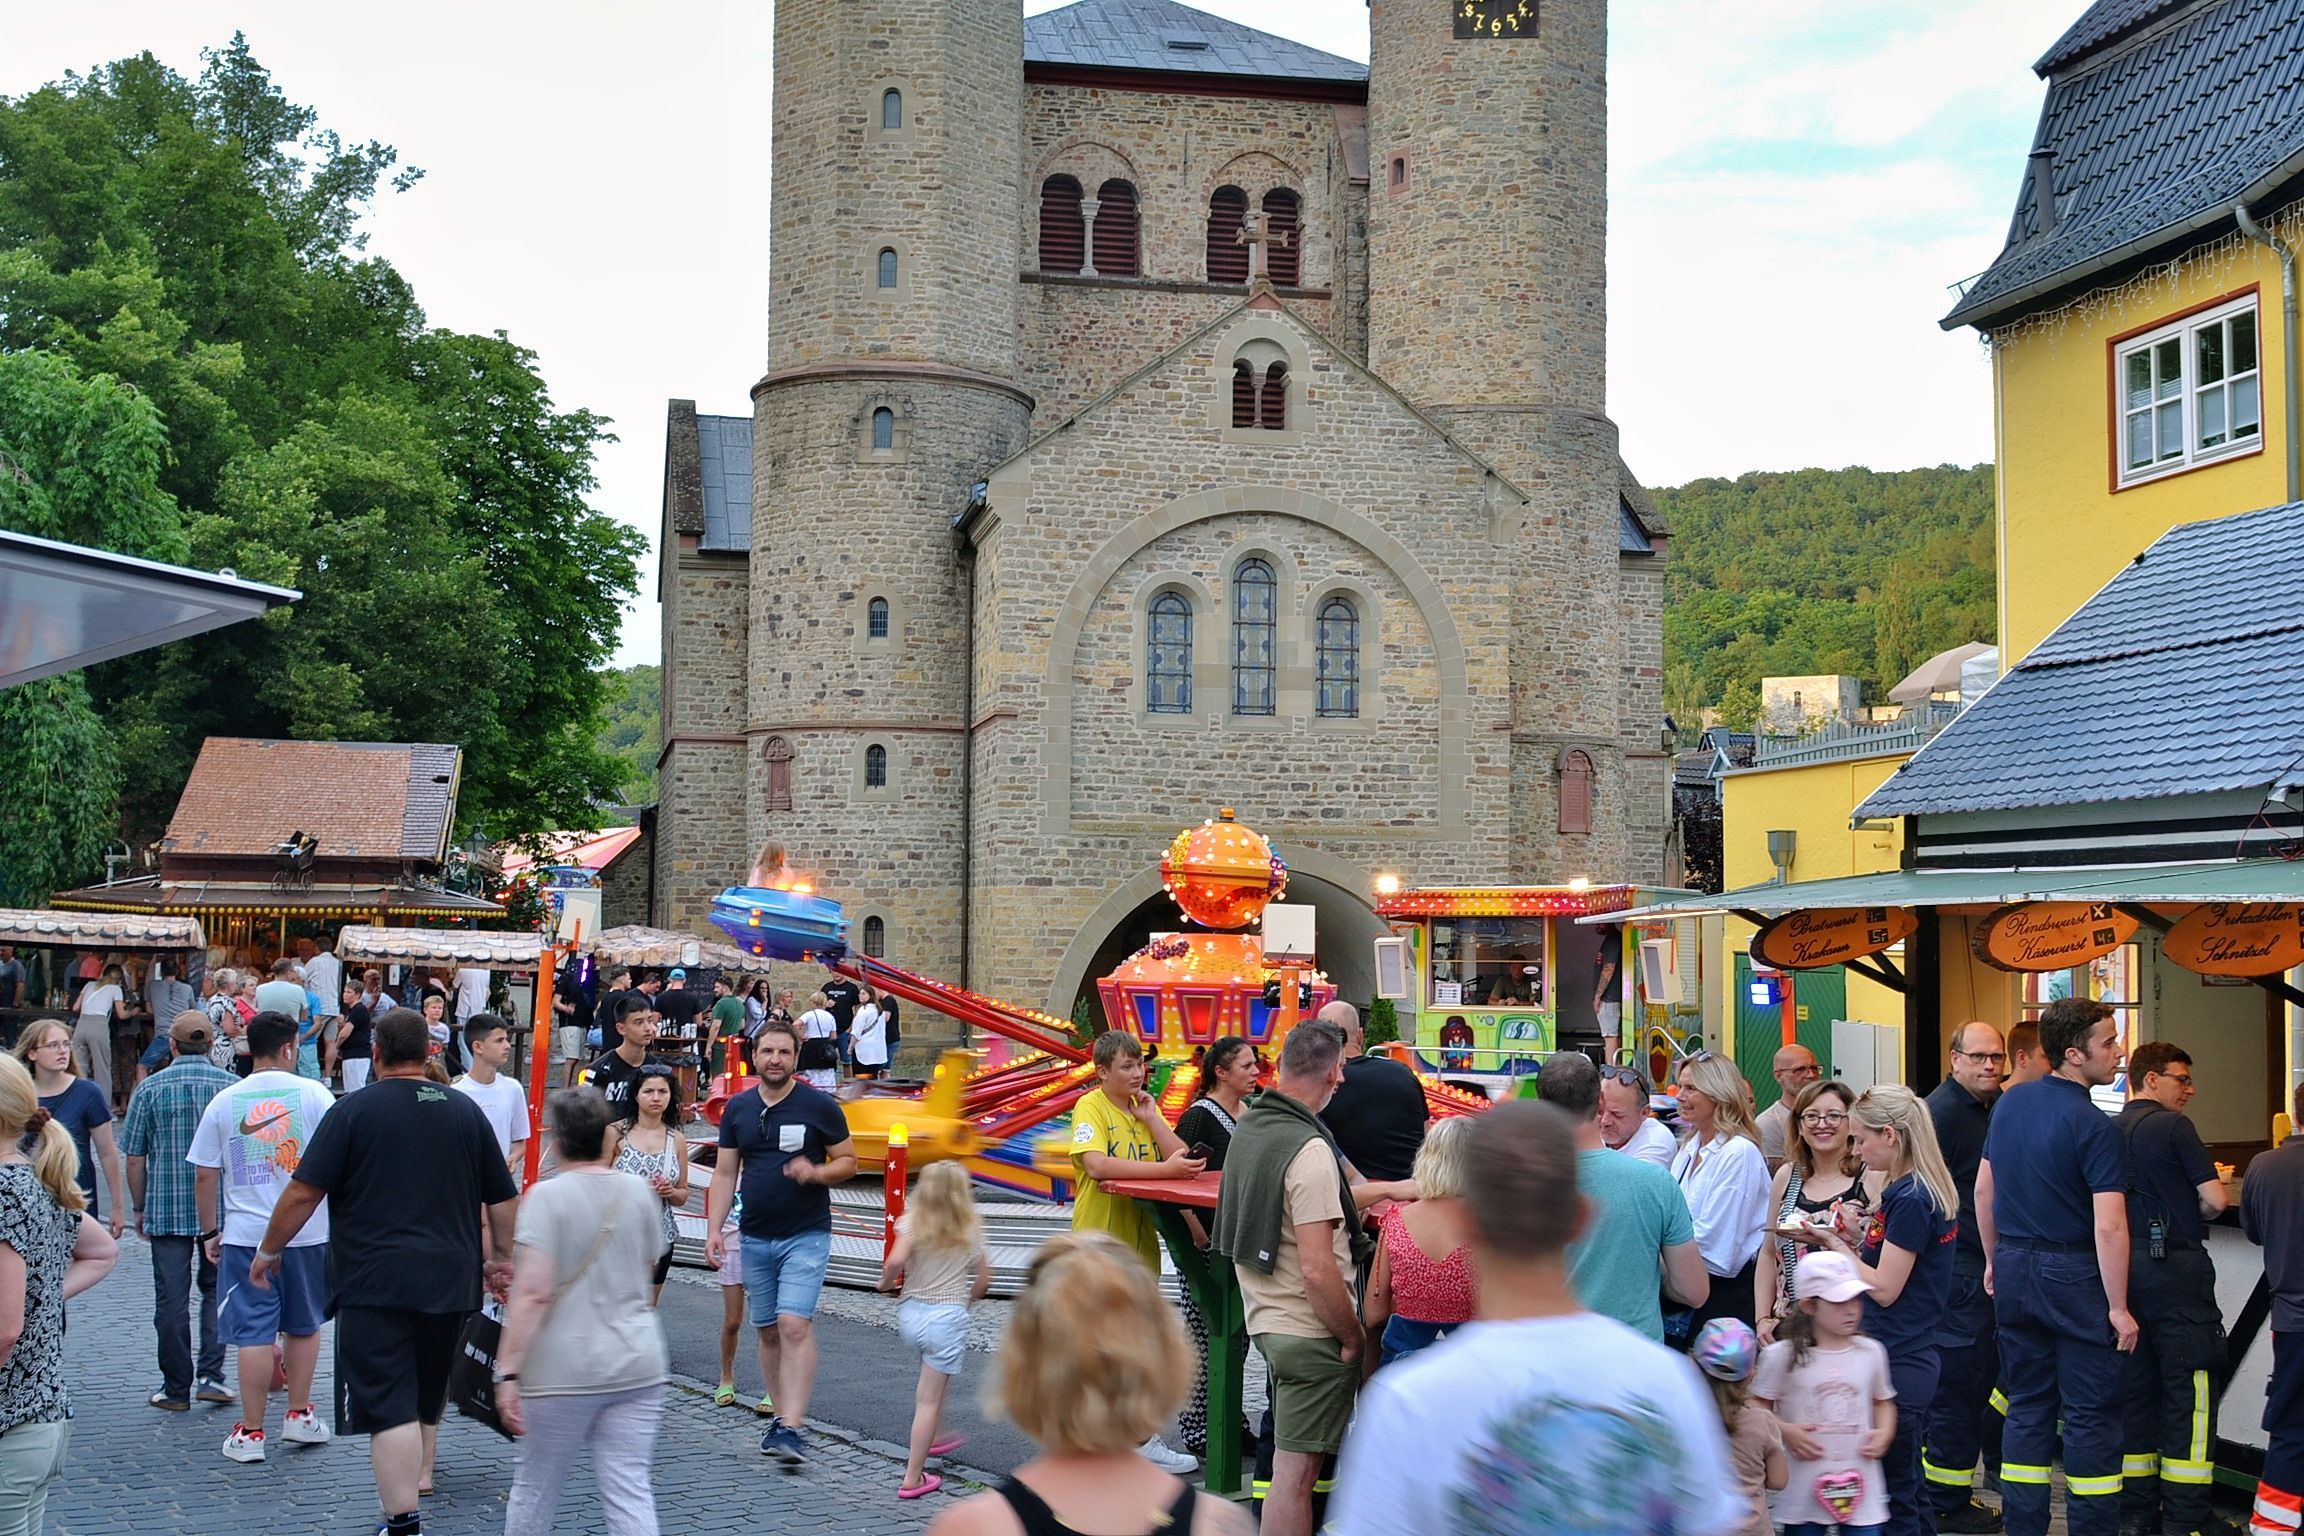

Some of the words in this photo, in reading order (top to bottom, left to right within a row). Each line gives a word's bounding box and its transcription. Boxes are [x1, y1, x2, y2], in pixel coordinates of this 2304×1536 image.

[1476, 14, 1486, 29] 7
[1491, 17, 1502, 32] 6
[1506, 13, 1518, 29] 5
[1789, 912, 1859, 938] Bratwurst
[2005, 911, 2089, 938] Rindswurst
[2204, 903, 2294, 928] Frikadellen
[1789, 938, 1851, 965] Krakauer
[2013, 935, 2088, 963] Käsewurst
[2196, 934, 2281, 964] Schnitzel
[247, 1165, 256, 1175] TO
[249, 1174, 271, 1186] LIGHT
